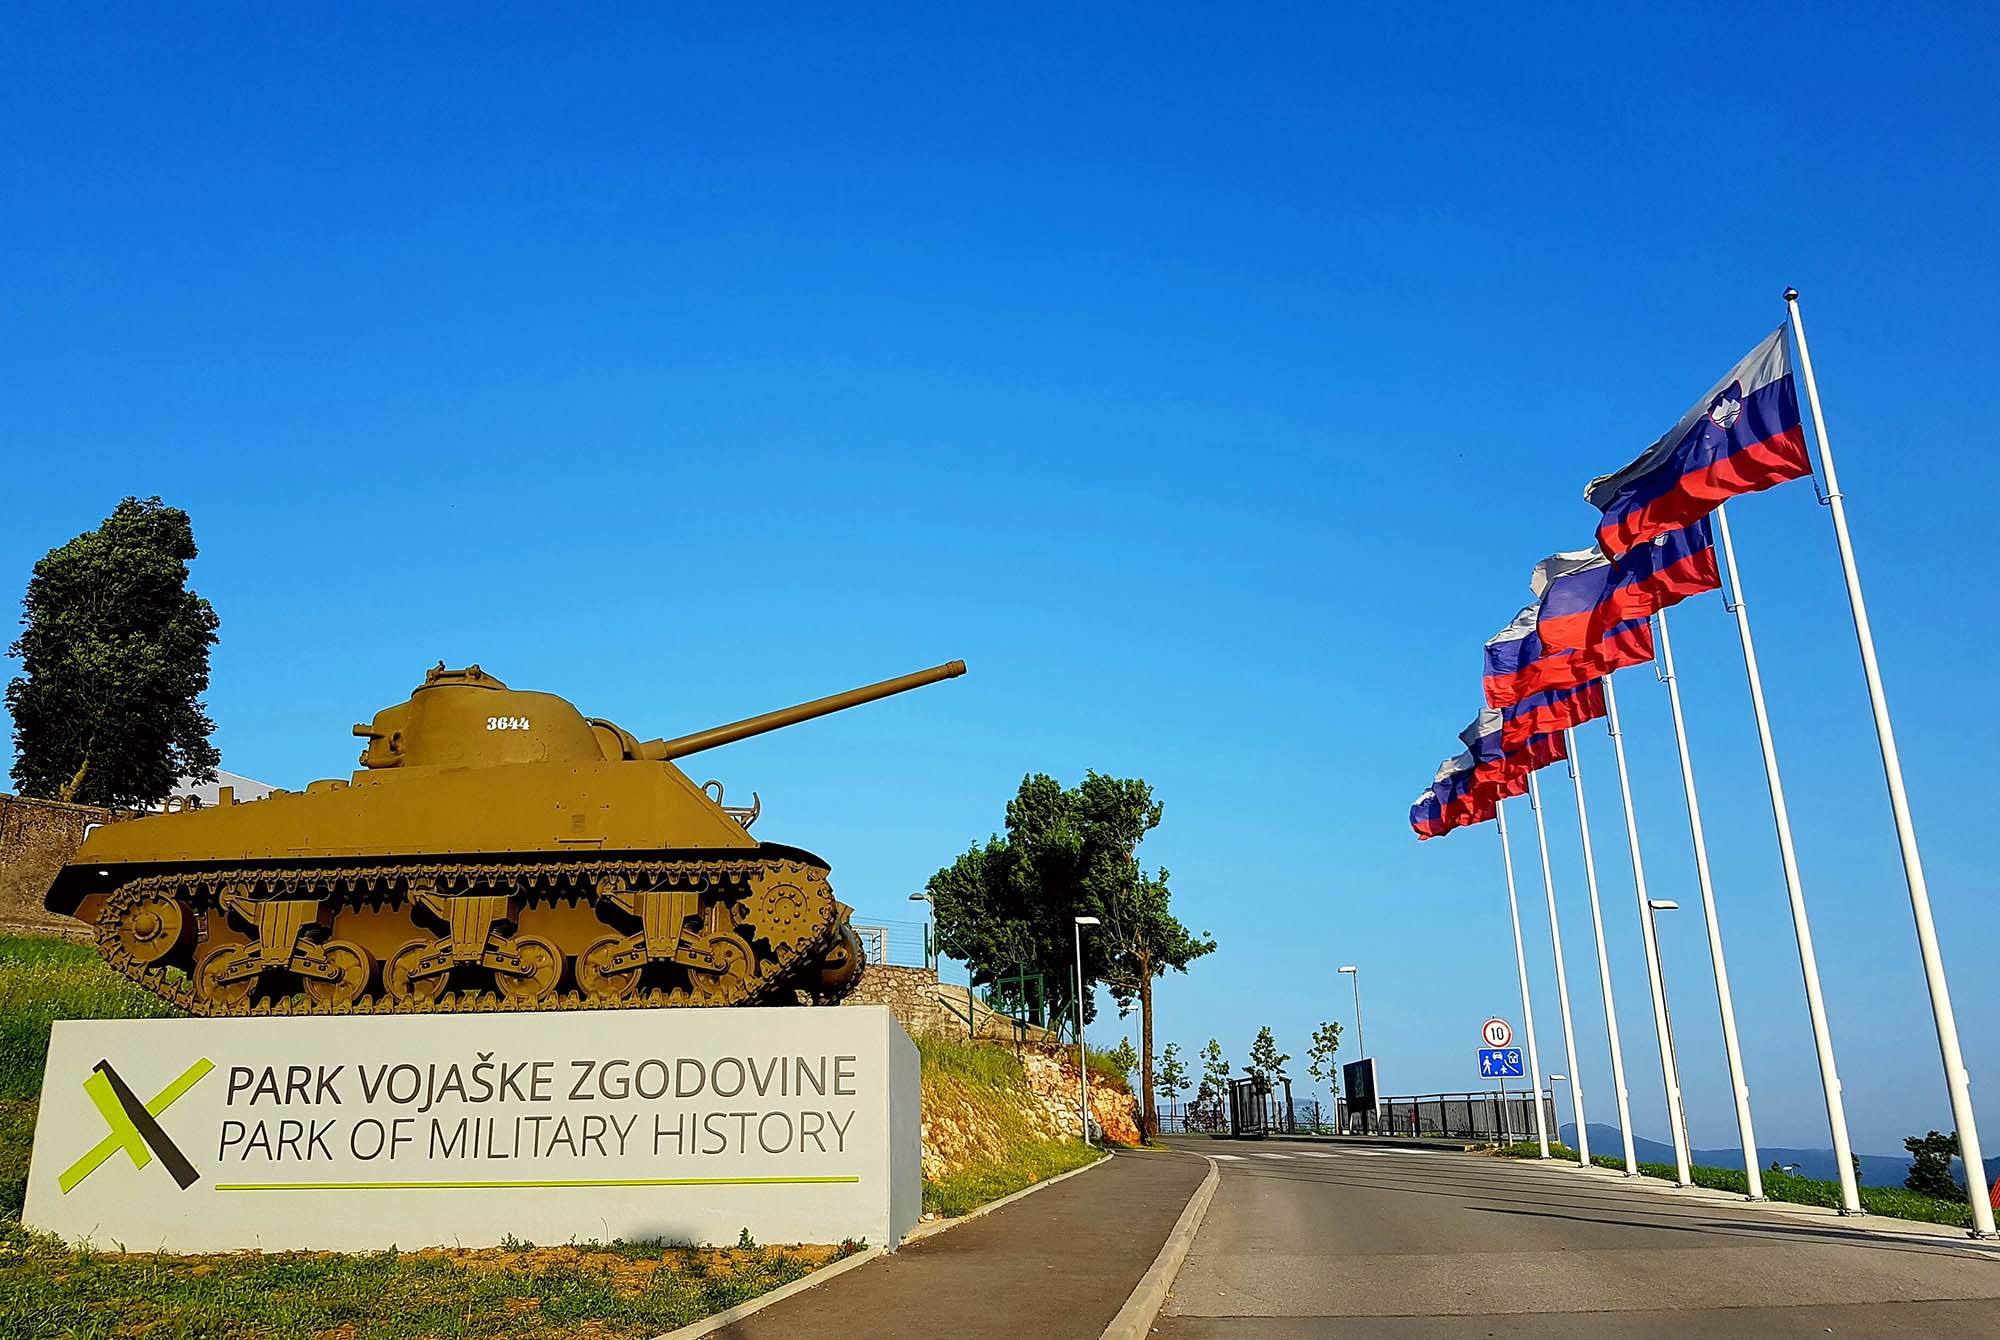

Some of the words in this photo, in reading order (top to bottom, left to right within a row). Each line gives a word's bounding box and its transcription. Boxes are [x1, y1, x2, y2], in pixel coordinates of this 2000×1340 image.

[486, 716, 531, 731] 3644
[1491, 1027, 1504, 1040] 10
[226, 1065, 346, 1106] PARK
[358, 1051, 555, 1113] VOJAŠKE
[568, 1055, 858, 1101] ZGODOVINE
[218, 1118, 337, 1162] PARK
[349, 1117, 415, 1161] OF
[428, 1114, 639, 1160] MILITARY
[653, 1109, 856, 1156] HISTORY
